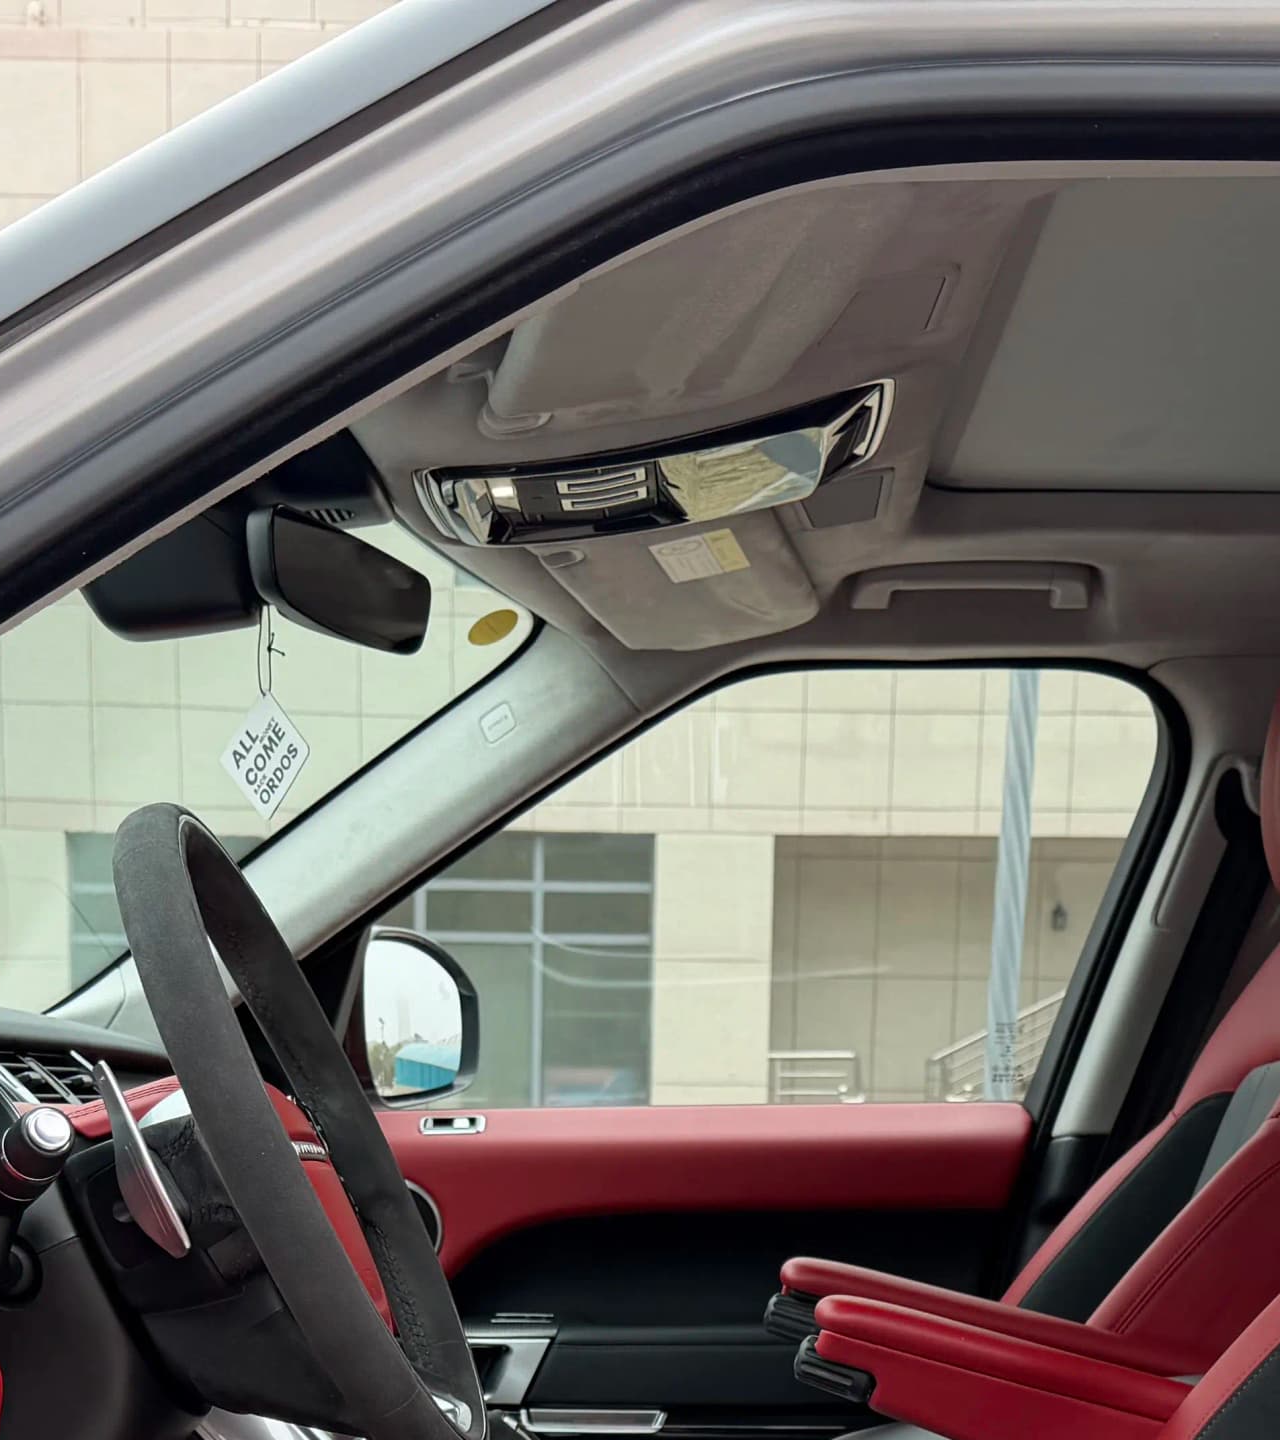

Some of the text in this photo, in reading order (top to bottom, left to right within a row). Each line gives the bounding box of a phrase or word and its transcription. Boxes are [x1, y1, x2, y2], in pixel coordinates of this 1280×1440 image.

[231, 730, 259, 769] ALL
[245, 722, 286, 786] COME
[259, 743, 299, 805] ORDOS
